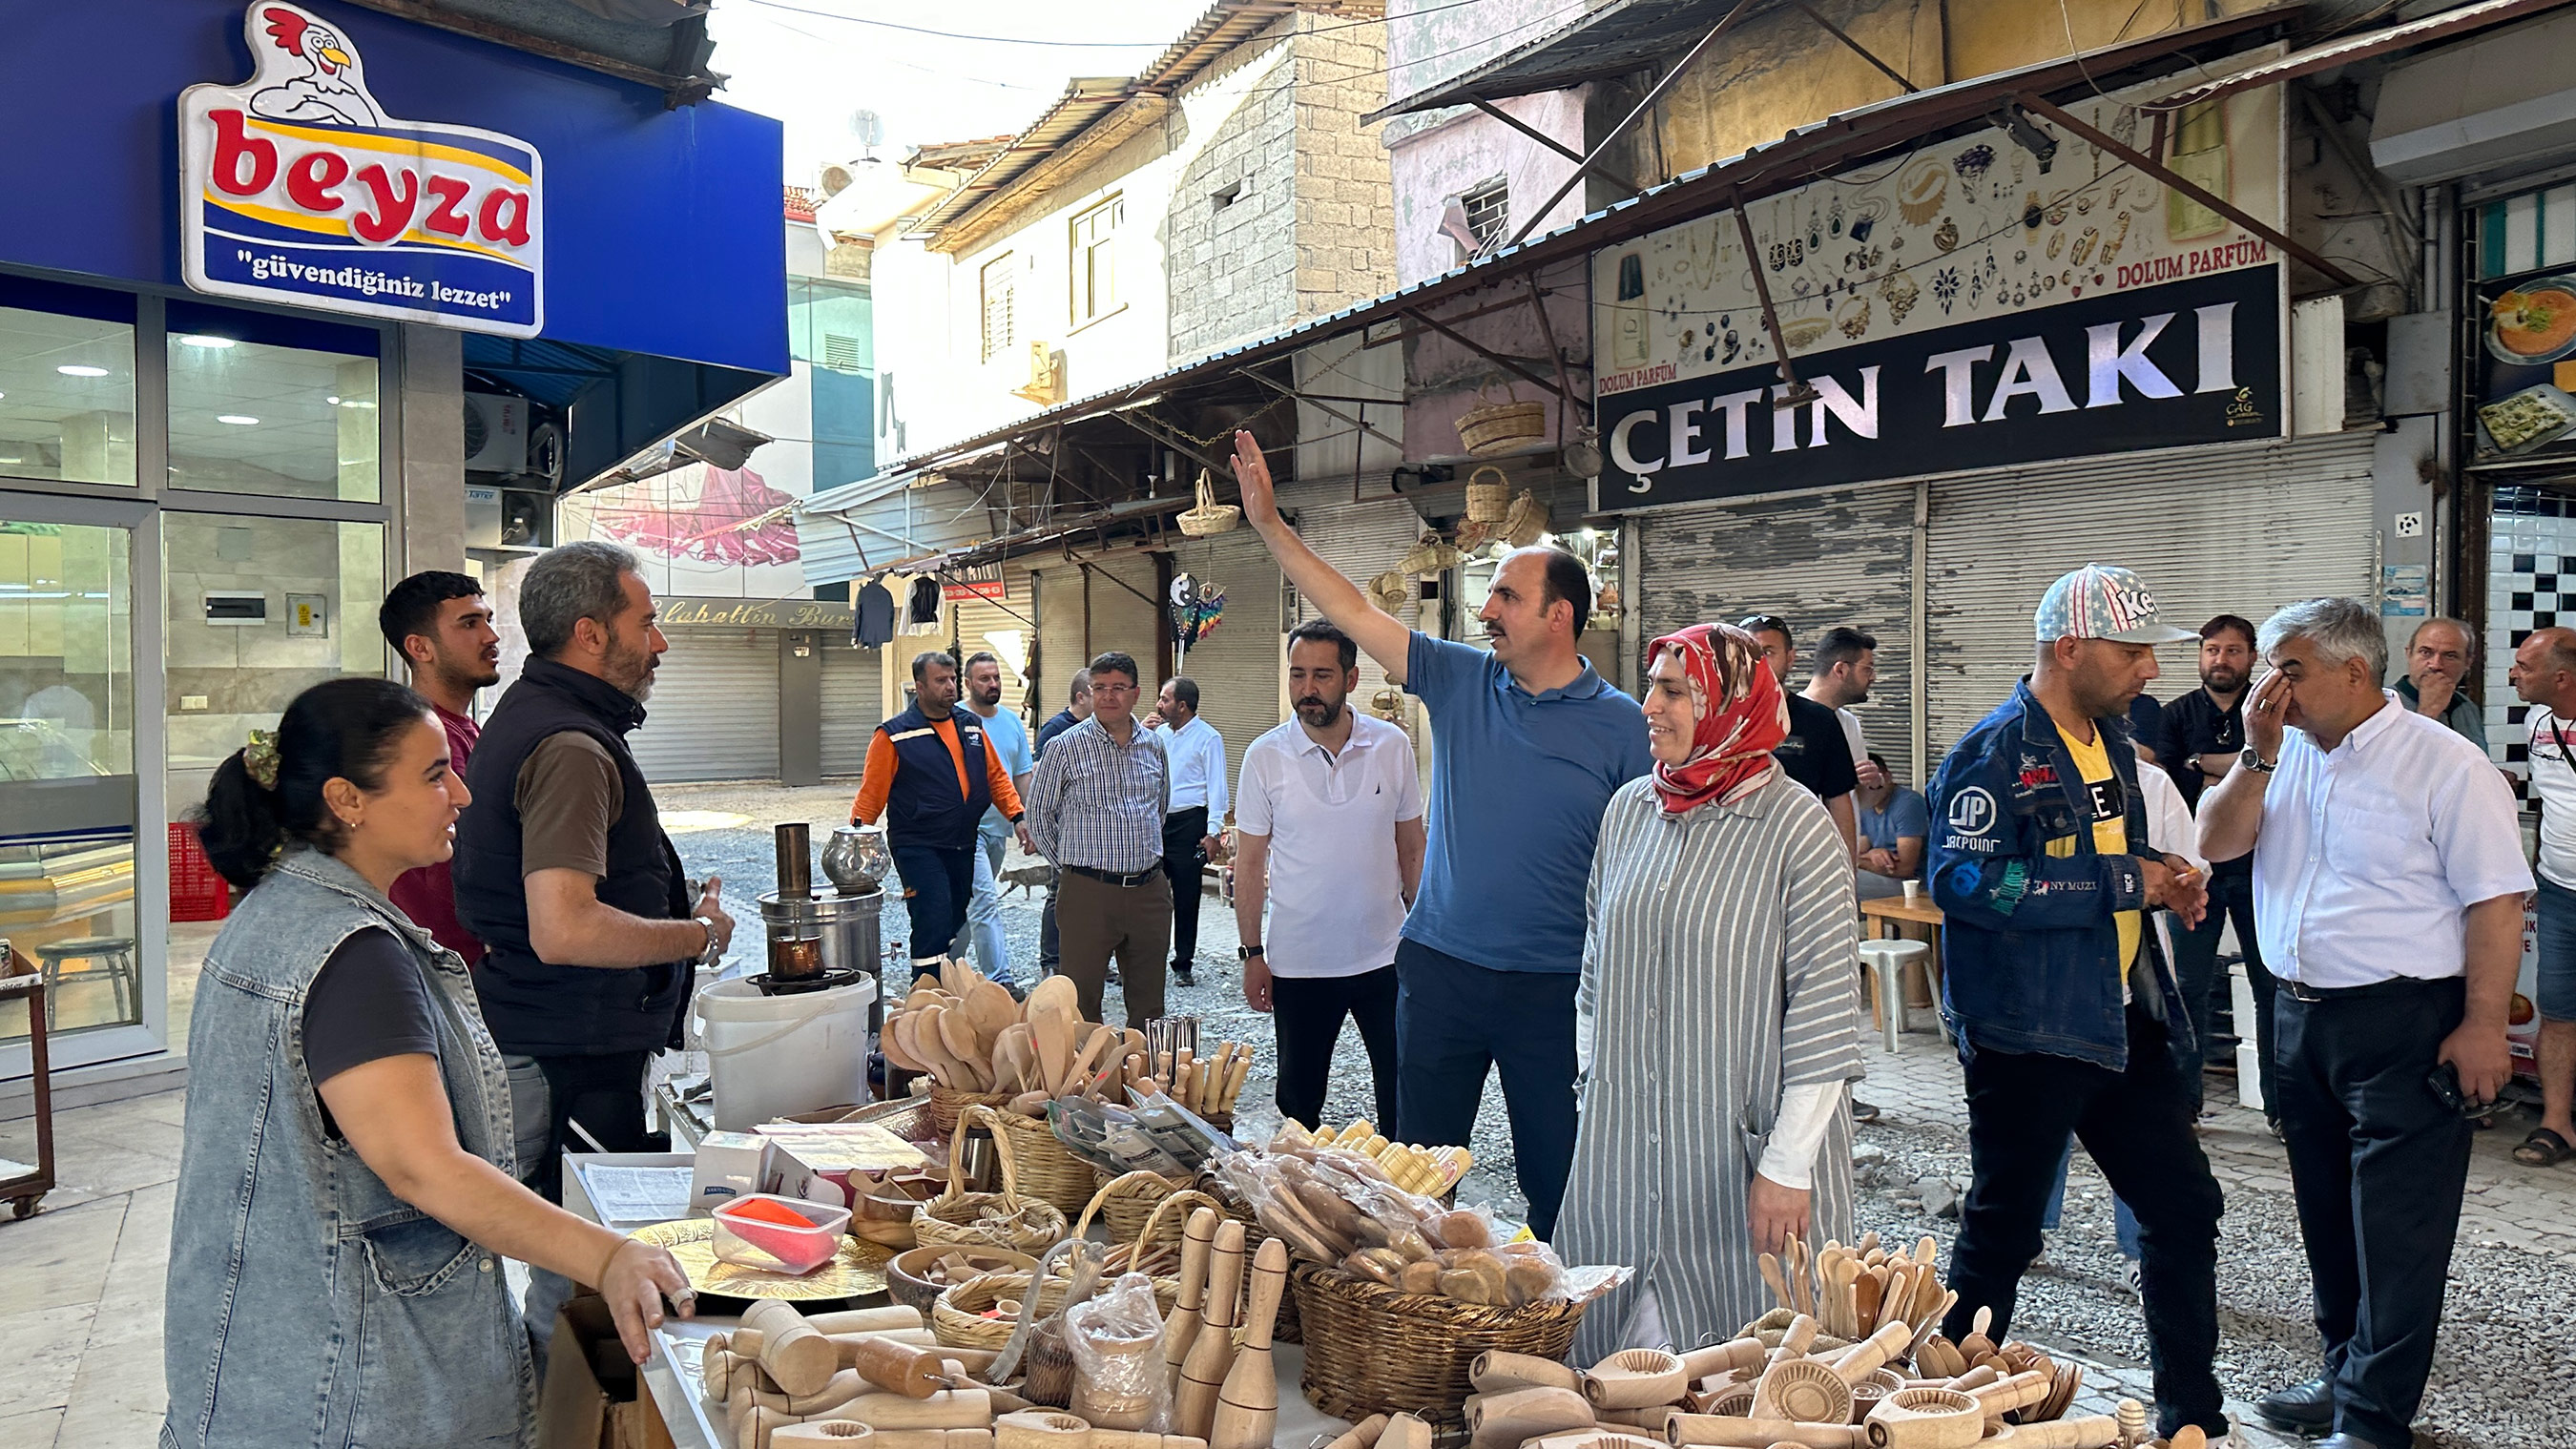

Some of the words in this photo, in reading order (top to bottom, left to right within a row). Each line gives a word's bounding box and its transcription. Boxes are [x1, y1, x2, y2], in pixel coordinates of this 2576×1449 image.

[207, 108, 531, 247] beyza
[237, 249, 425, 296] "güvendiğiniz
[431, 280, 512, 310] lezzet"
[2116, 254, 2184, 288] DOLUM
[2189, 233, 2268, 276] PARFÜM
[1598, 371, 1634, 394] DOLUM
[1636, 359, 1677, 387] PARFÜM
[1610, 364, 1882, 494] ÇETİN
[1924, 300, 2239, 429] TAKI
[2116, 590, 2158, 621] Ke
[1949, 795, 1987, 827] JP
